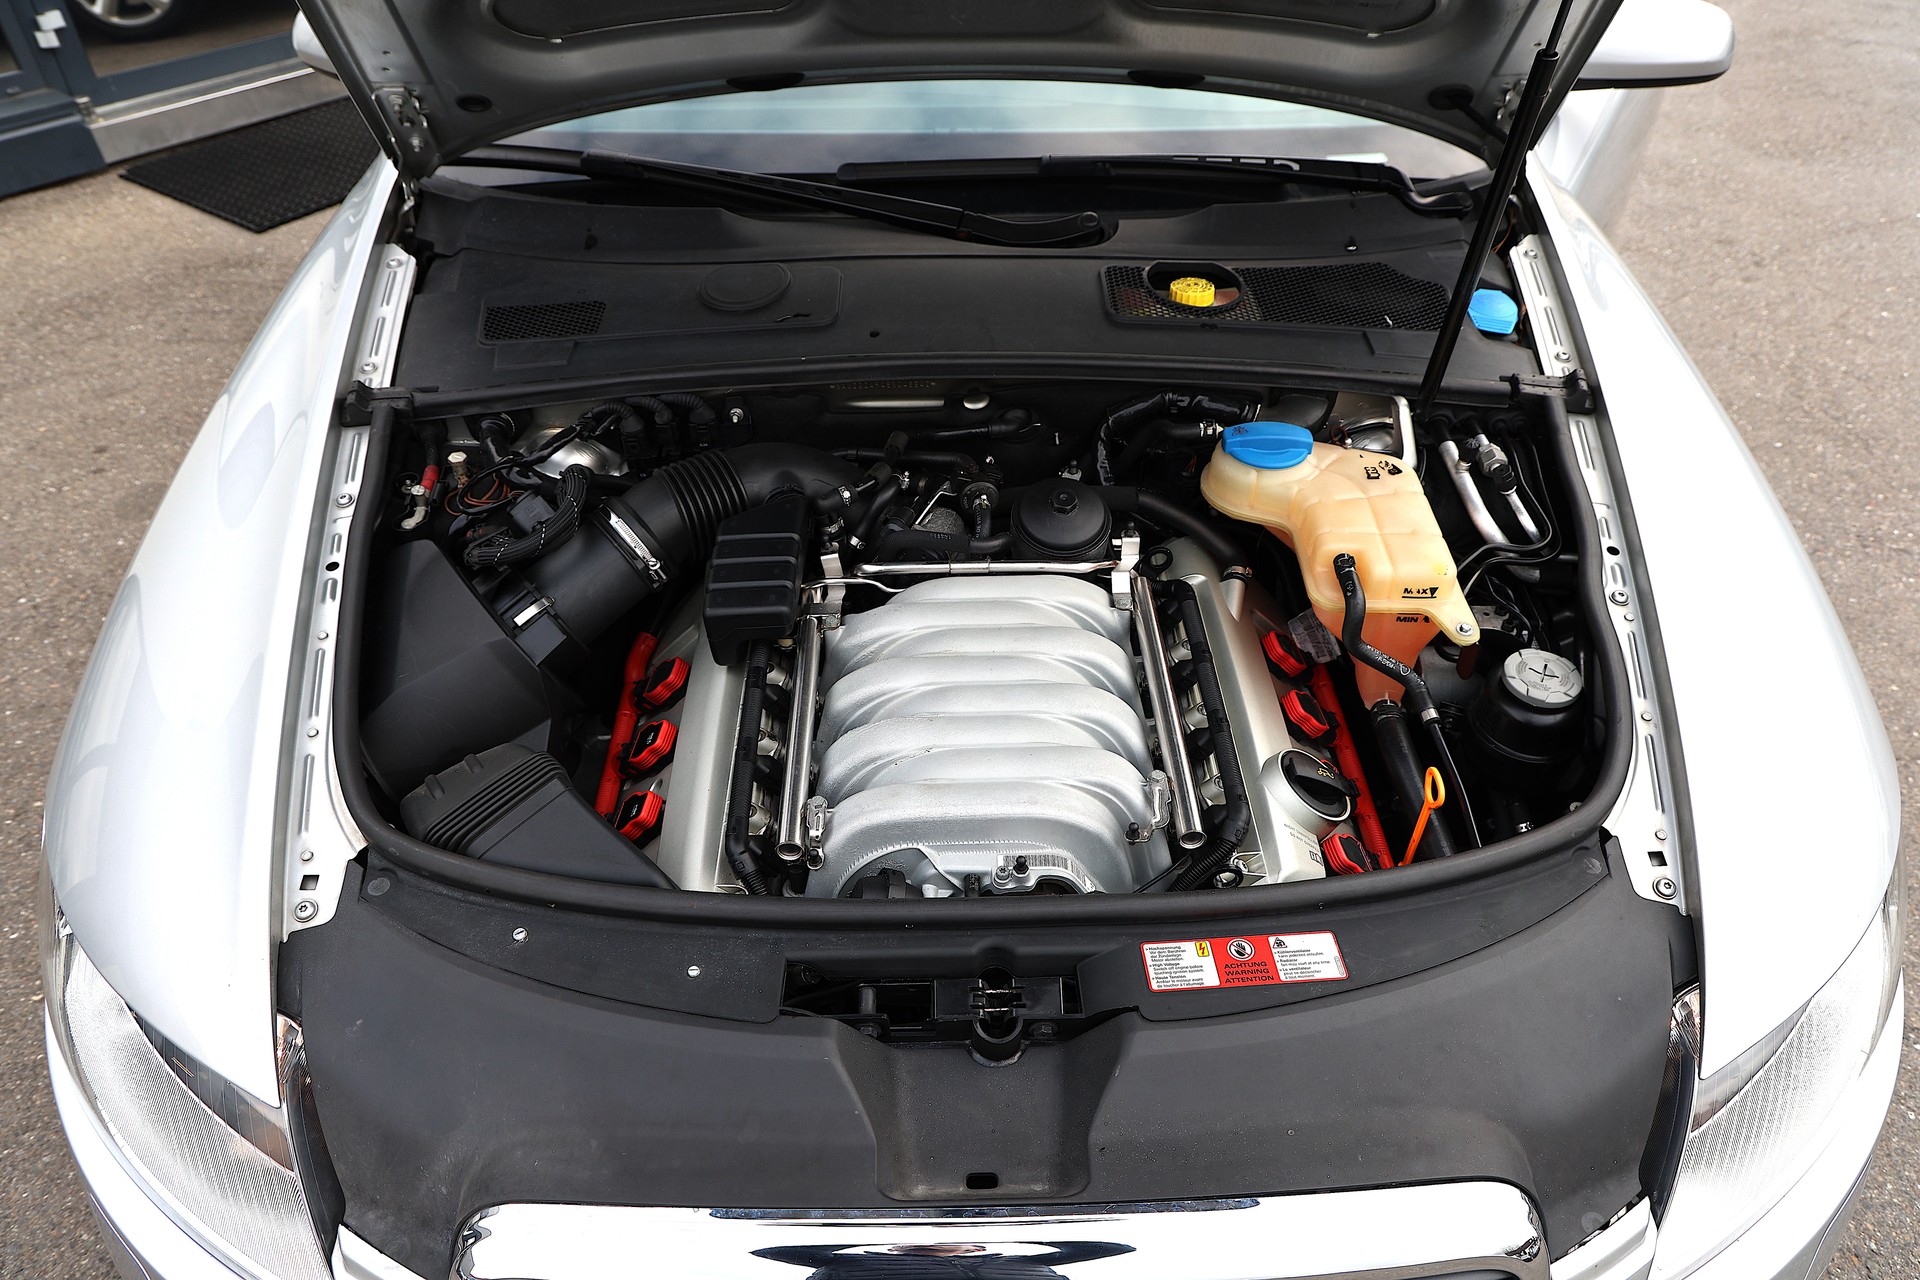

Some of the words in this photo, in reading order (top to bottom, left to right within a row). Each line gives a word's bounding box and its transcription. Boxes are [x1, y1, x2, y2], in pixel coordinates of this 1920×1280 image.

[1224, 961, 1267, 969] ACHTUNG
[1225, 968, 1270, 976] WARNING
[1225, 975, 1274, 984] ATTENTION
